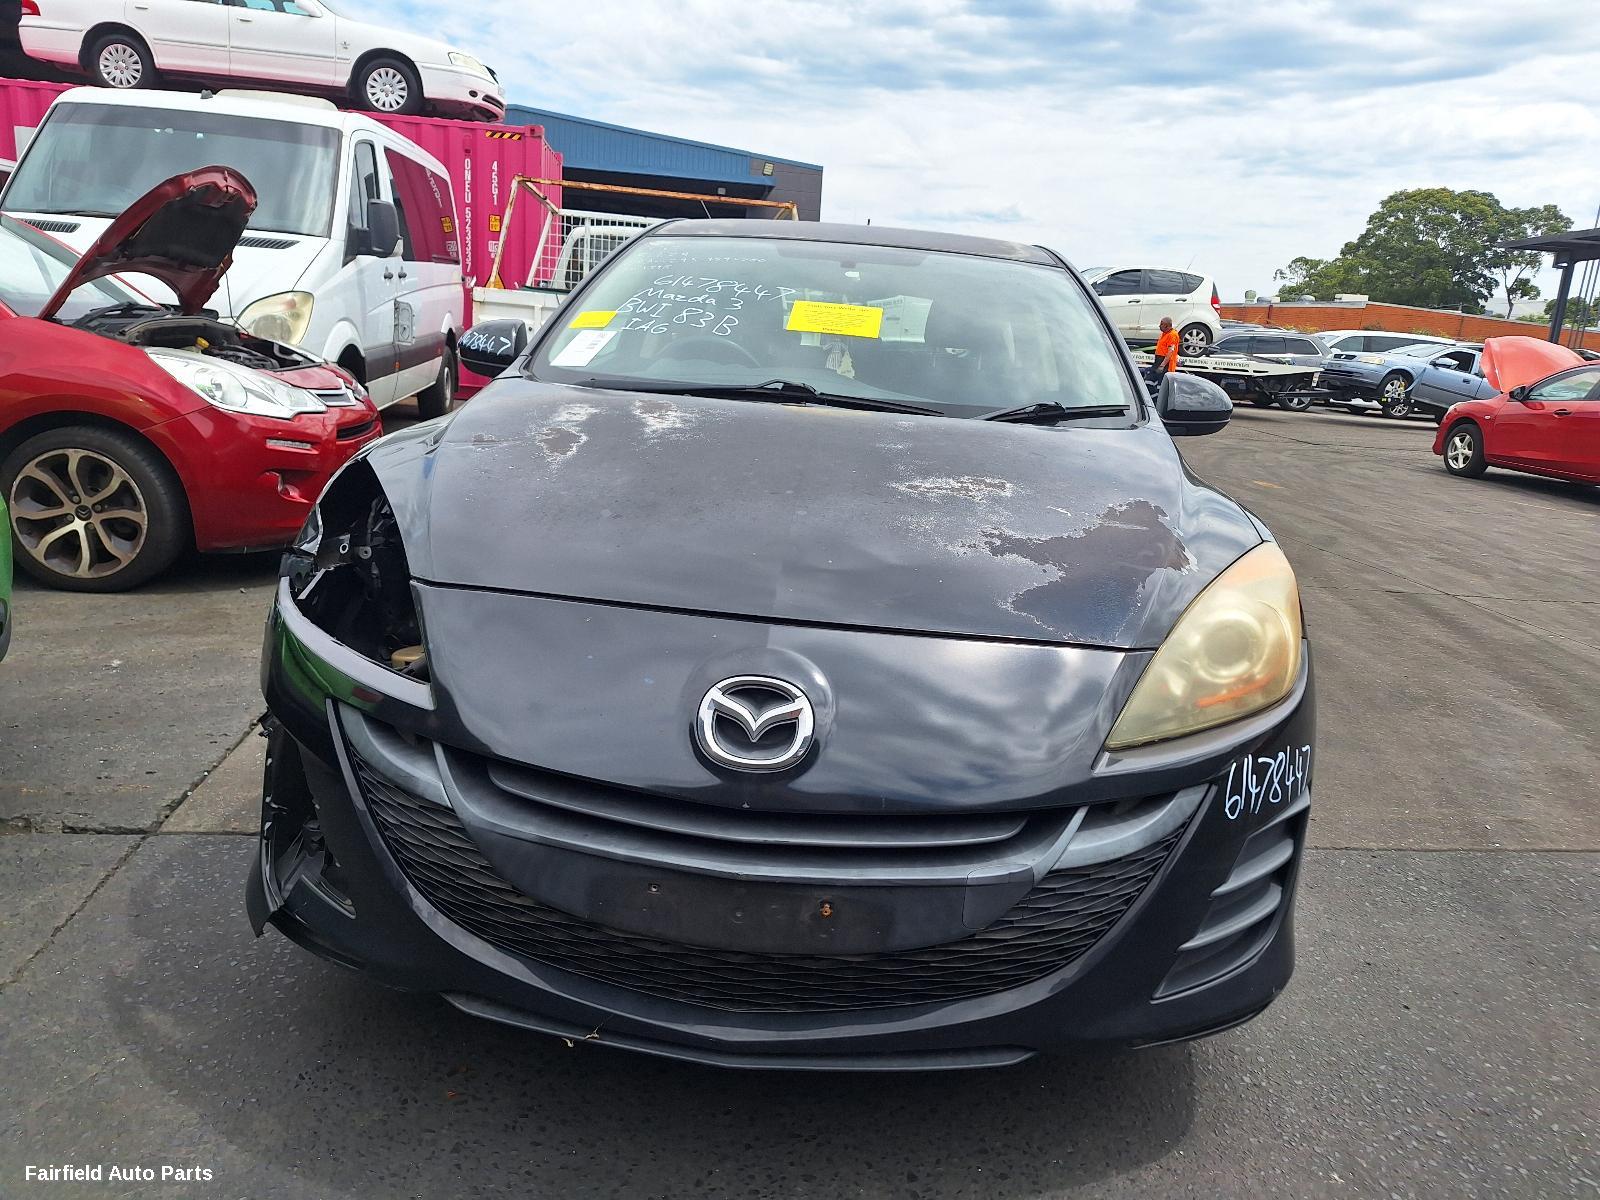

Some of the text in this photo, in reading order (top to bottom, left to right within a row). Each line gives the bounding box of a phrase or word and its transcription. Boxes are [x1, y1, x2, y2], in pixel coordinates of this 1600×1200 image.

[464, 158, 472, 204] ONEU
[491, 160, 499, 206] 45G1
[634, 287, 744, 310] Mazda 3
[653, 274, 797, 302] 61478447
[672, 307, 739, 336] 83B
[1224, 744, 1311, 820] 61478447
